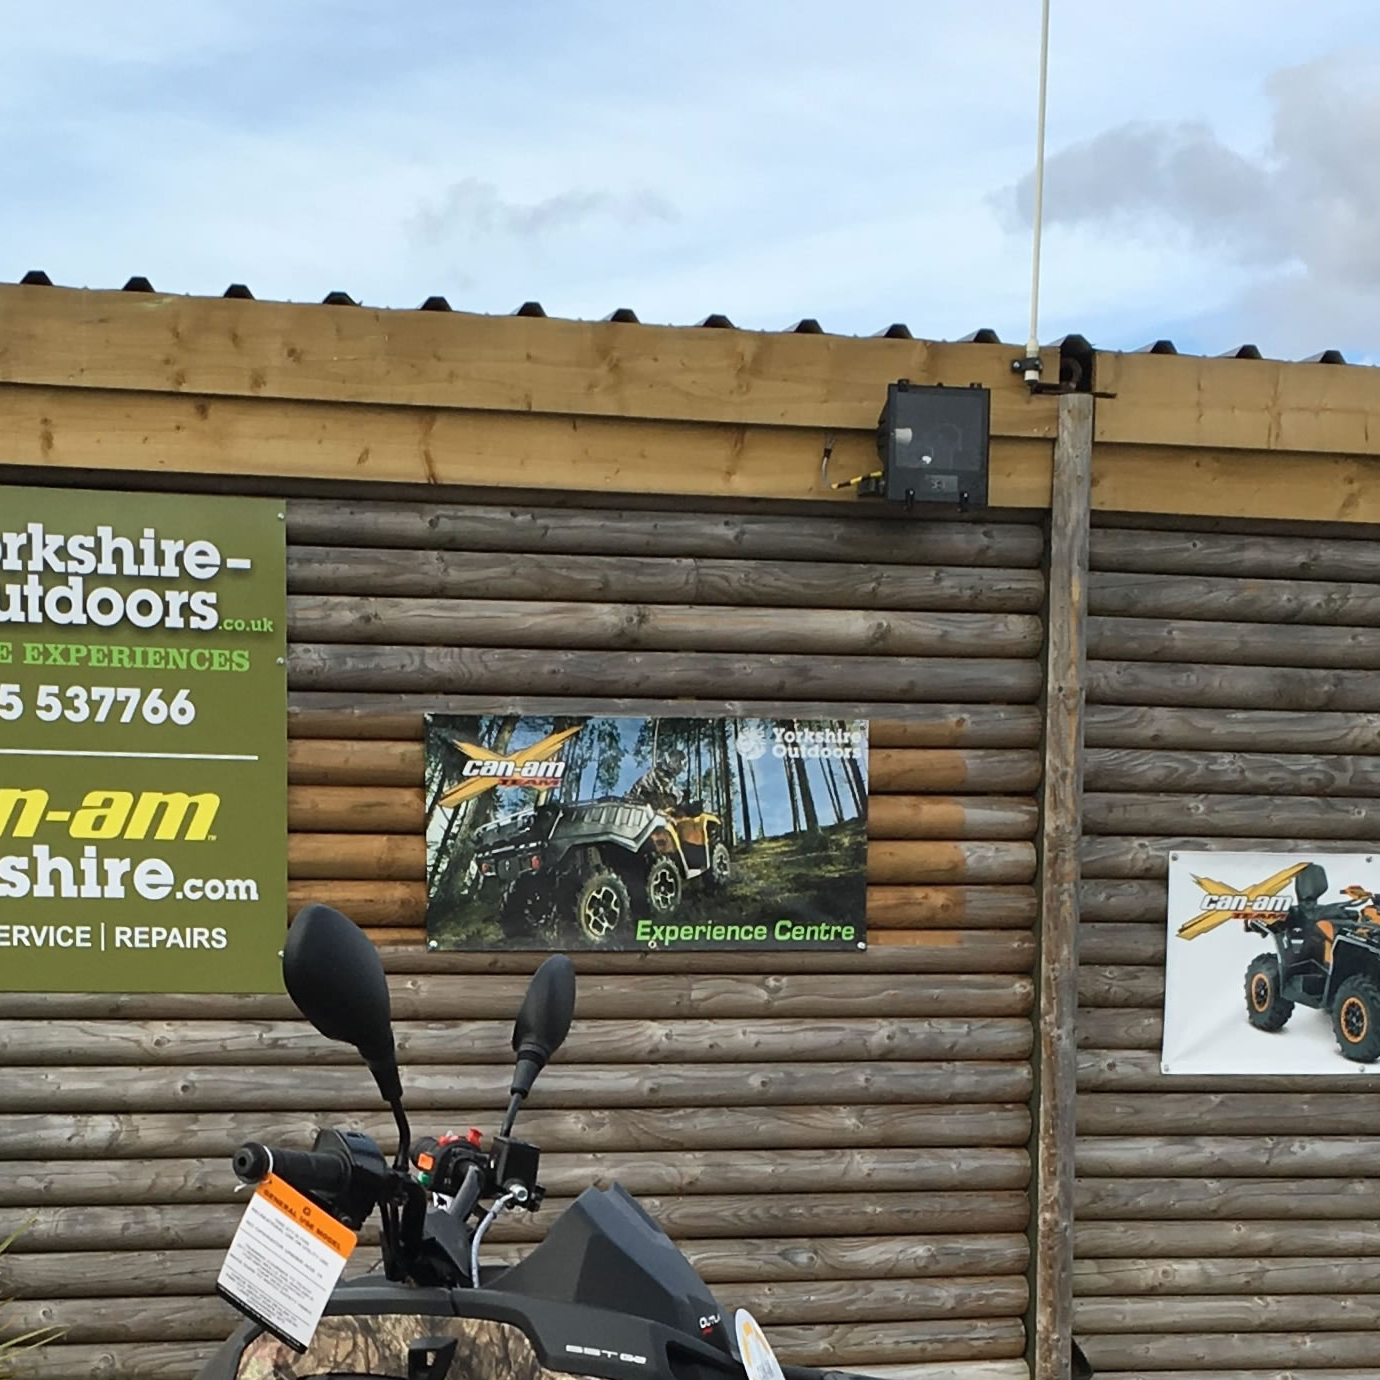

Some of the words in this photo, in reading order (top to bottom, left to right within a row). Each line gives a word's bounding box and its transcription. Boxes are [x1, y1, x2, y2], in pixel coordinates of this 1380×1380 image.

[22, 643, 251, 673] EXPERIENCES
[35, 685, 196, 725] 537766
[771, 728, 862, 744] Yorkshire
[771, 744, 862, 760] Outdoors
[461, 759, 566, 778] can-am
[1199, 894, 1294, 912] can-am
[114, 926, 228, 949] REPAIRS
[635, 920, 768, 947] Experience
[773, 920, 856, 942] Centre
